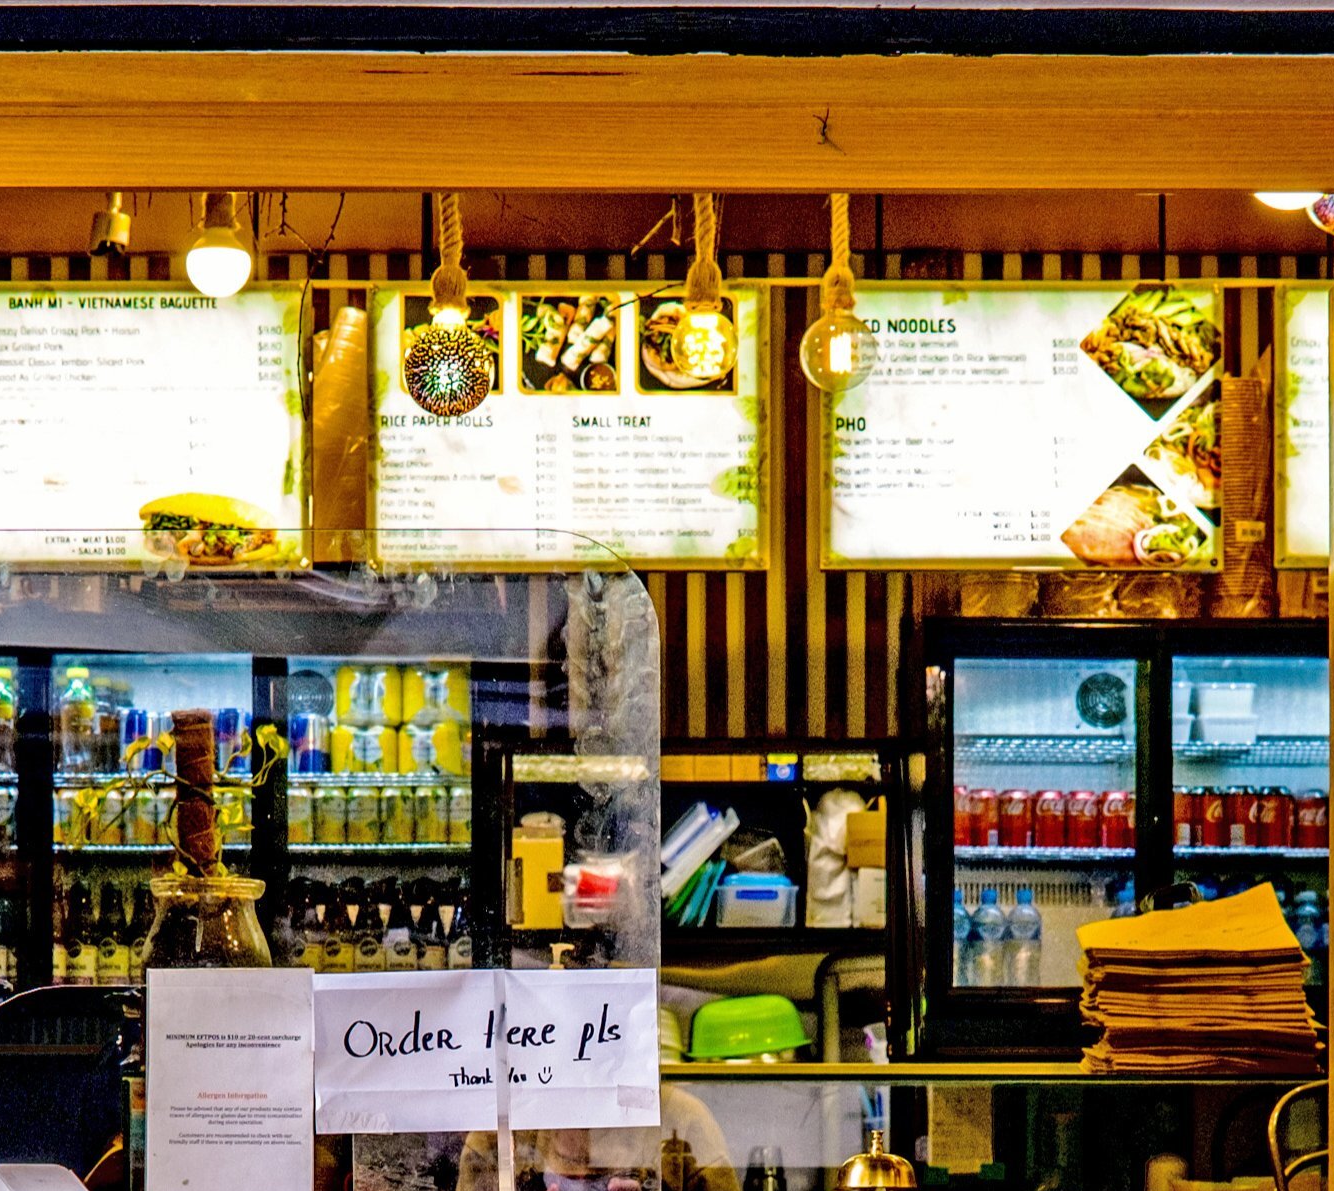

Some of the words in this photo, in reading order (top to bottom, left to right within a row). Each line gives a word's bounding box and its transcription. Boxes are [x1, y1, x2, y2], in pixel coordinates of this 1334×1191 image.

[8, 297, 43, 310] BANH
[48, 297, 62, 309] MI
[78, 297, 154, 309] VIETNAMESE
[160, 296, 216, 309] BAGUETTE
[887, 319, 956, 333] NOODLES
[381, 416, 406, 427] RICE
[456, 416, 493, 427] ROLLS
[572, 416, 612, 428] SMALL
[617, 416, 651, 427] TREAT
[836, 418, 866, 431] PHO
[573, 1004, 621, 1061] pls
[449, 1067, 493, 1087] Thank
[197, 1092, 226, 1100] Allergen
[227, 1092, 268, 1100] Information
